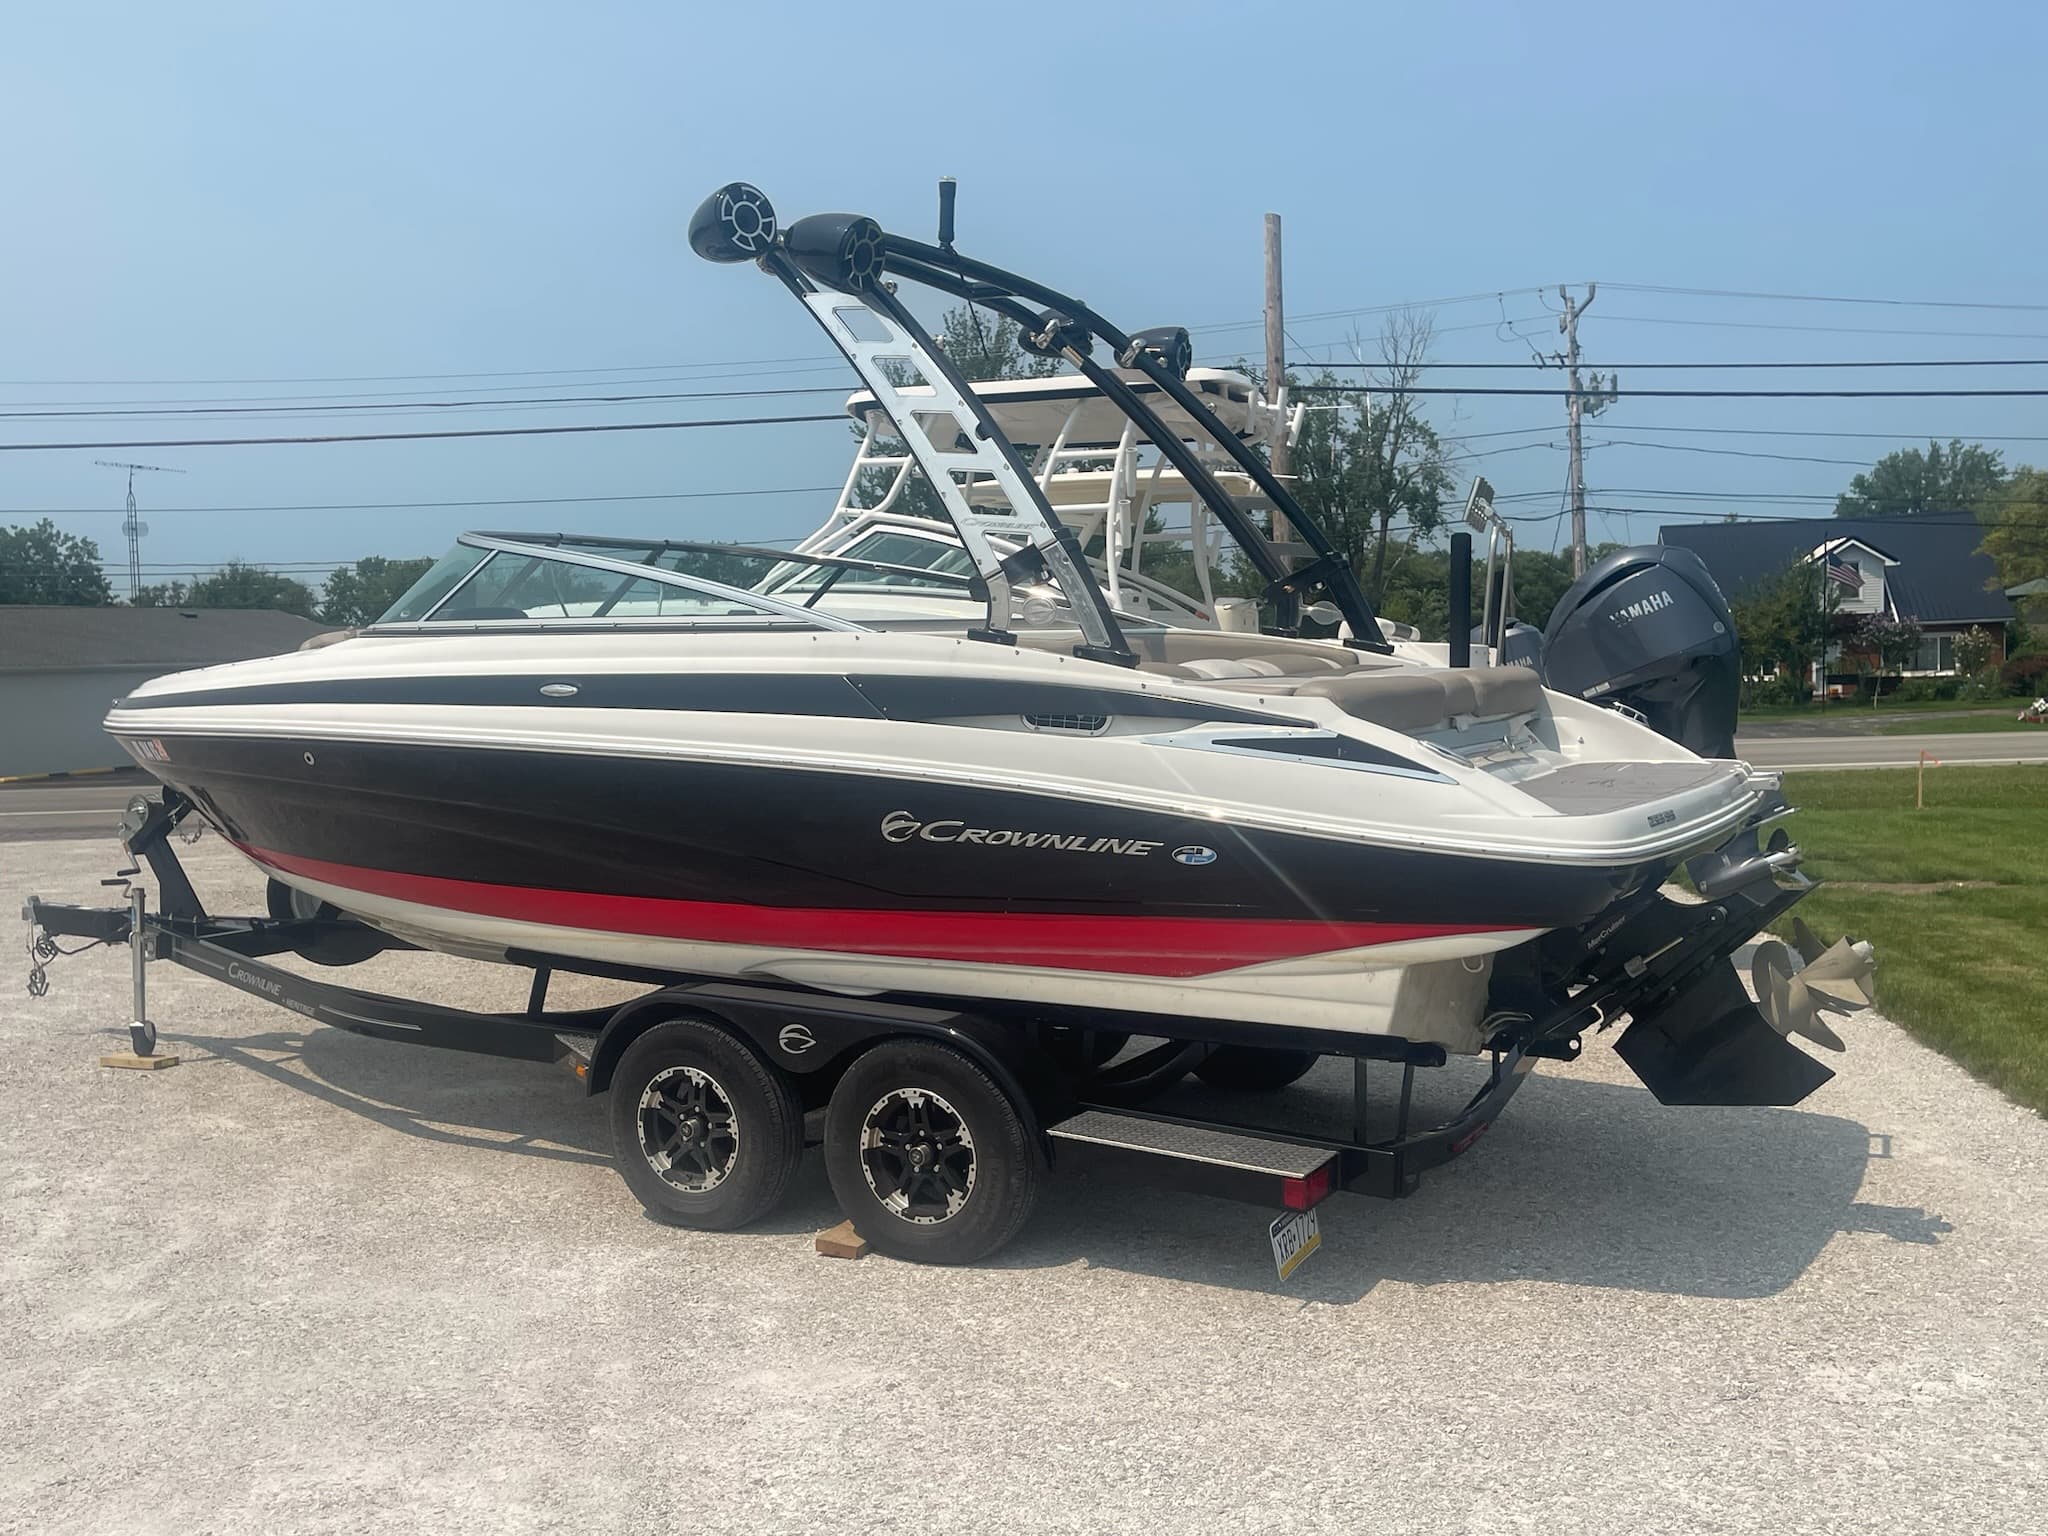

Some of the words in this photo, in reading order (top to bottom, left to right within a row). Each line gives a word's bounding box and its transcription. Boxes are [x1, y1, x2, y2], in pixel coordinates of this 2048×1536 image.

[1608, 590, 1673, 627] YAMAHA
[920, 820, 1164, 856] CROWNLINE
[229, 963, 282, 997] CROWNLINE
